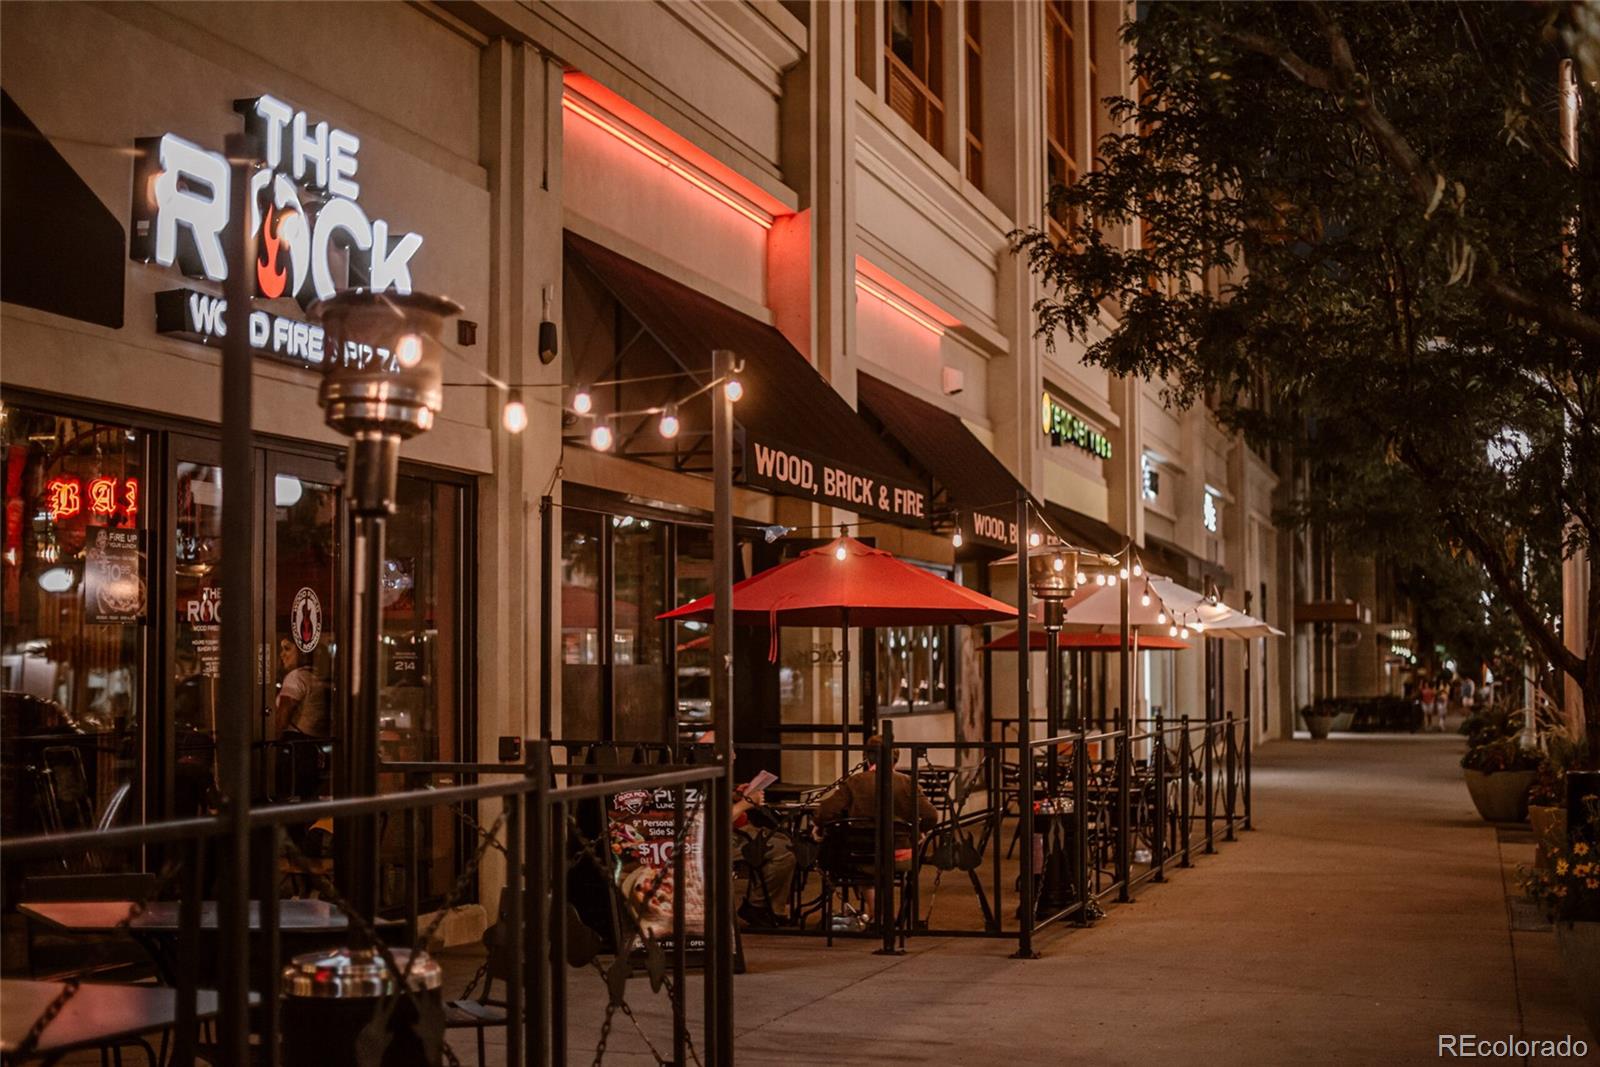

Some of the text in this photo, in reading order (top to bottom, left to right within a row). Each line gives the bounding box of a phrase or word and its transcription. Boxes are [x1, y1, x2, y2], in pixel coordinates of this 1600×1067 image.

[255, 93, 360, 200] THE
[155, 132, 423, 301] ROCK
[189, 292, 270, 348] WOD
[754, 442, 925, 519] WOOD, BRICK & FIRE
[109, 532, 138, 543] FIRE UP
[973, 511, 1007, 545] WOOD,
[203, 587, 222, 599] THE
[187, 600, 222, 623] ROC
[394, 661, 416, 672] 214
[649, 828, 665, 836] Side
